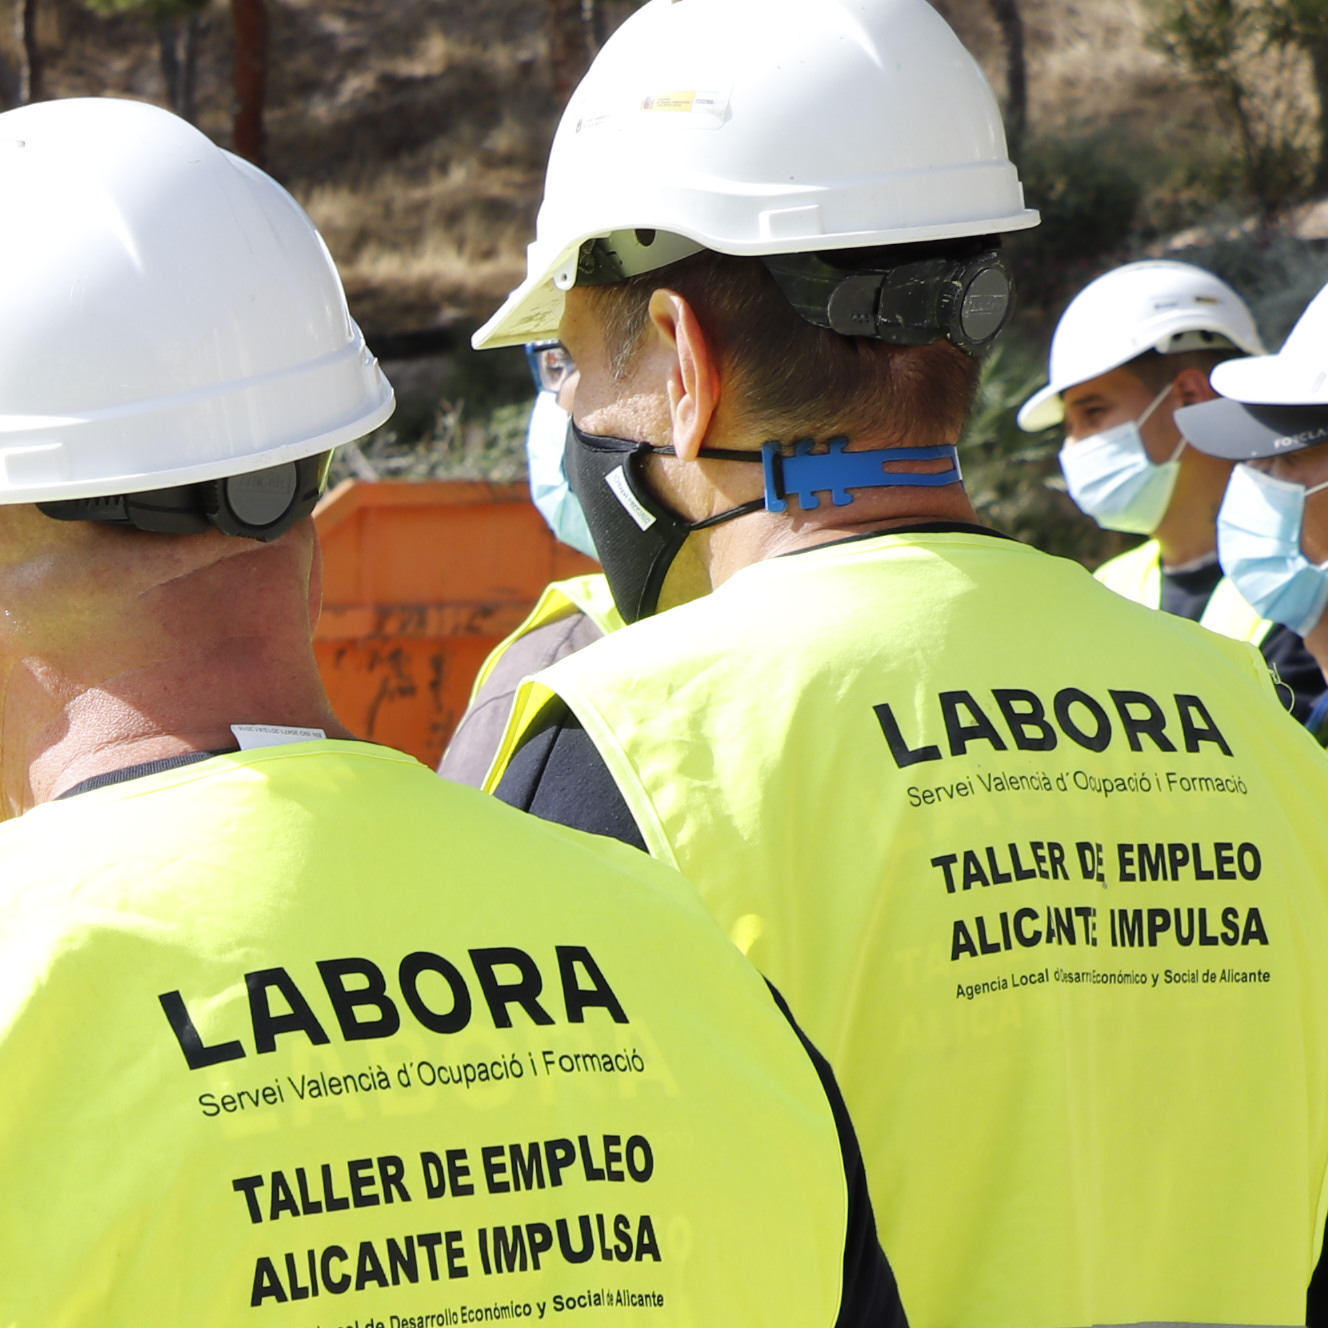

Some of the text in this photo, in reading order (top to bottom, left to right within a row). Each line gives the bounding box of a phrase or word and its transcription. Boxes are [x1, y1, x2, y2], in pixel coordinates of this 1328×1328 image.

[872, 687, 1234, 769] LABORA
[907, 776, 975, 808] Servei
[977, 772, 1053, 795] Valencià
[1156, 773, 1161, 793] i
[1166, 771, 1248, 796] Formació
[931, 841, 1262, 894] TALLER DE EMPLEO
[1109, 907, 1270, 948] IMPULSA
[158, 945, 630, 1070] LABORA
[955, 977, 1008, 1000] Agencia
[1011, 968, 1049, 988] Local
[1151, 973, 1159, 988] y
[1164, 969, 1199, 985] Social
[1202, 969, 1217, 984] de
[1219, 969, 1271, 984] Alicante
[198, 1084, 285, 1117] Servei
[287, 1069, 391, 1102] Valencià
[531, 1053, 538, 1077] i
[543, 1047, 645, 1077] Formació
[232, 1134, 654, 1224] TALLER DE EMPLEO
[250, 1213, 662, 1307] ALICANTE IMPULSA
[460, 1301, 532, 1325] Económico
[536, 1300, 547, 1319] y
[552, 1288, 605, 1313] Social
[615, 1288, 665, 1309] Alicante
